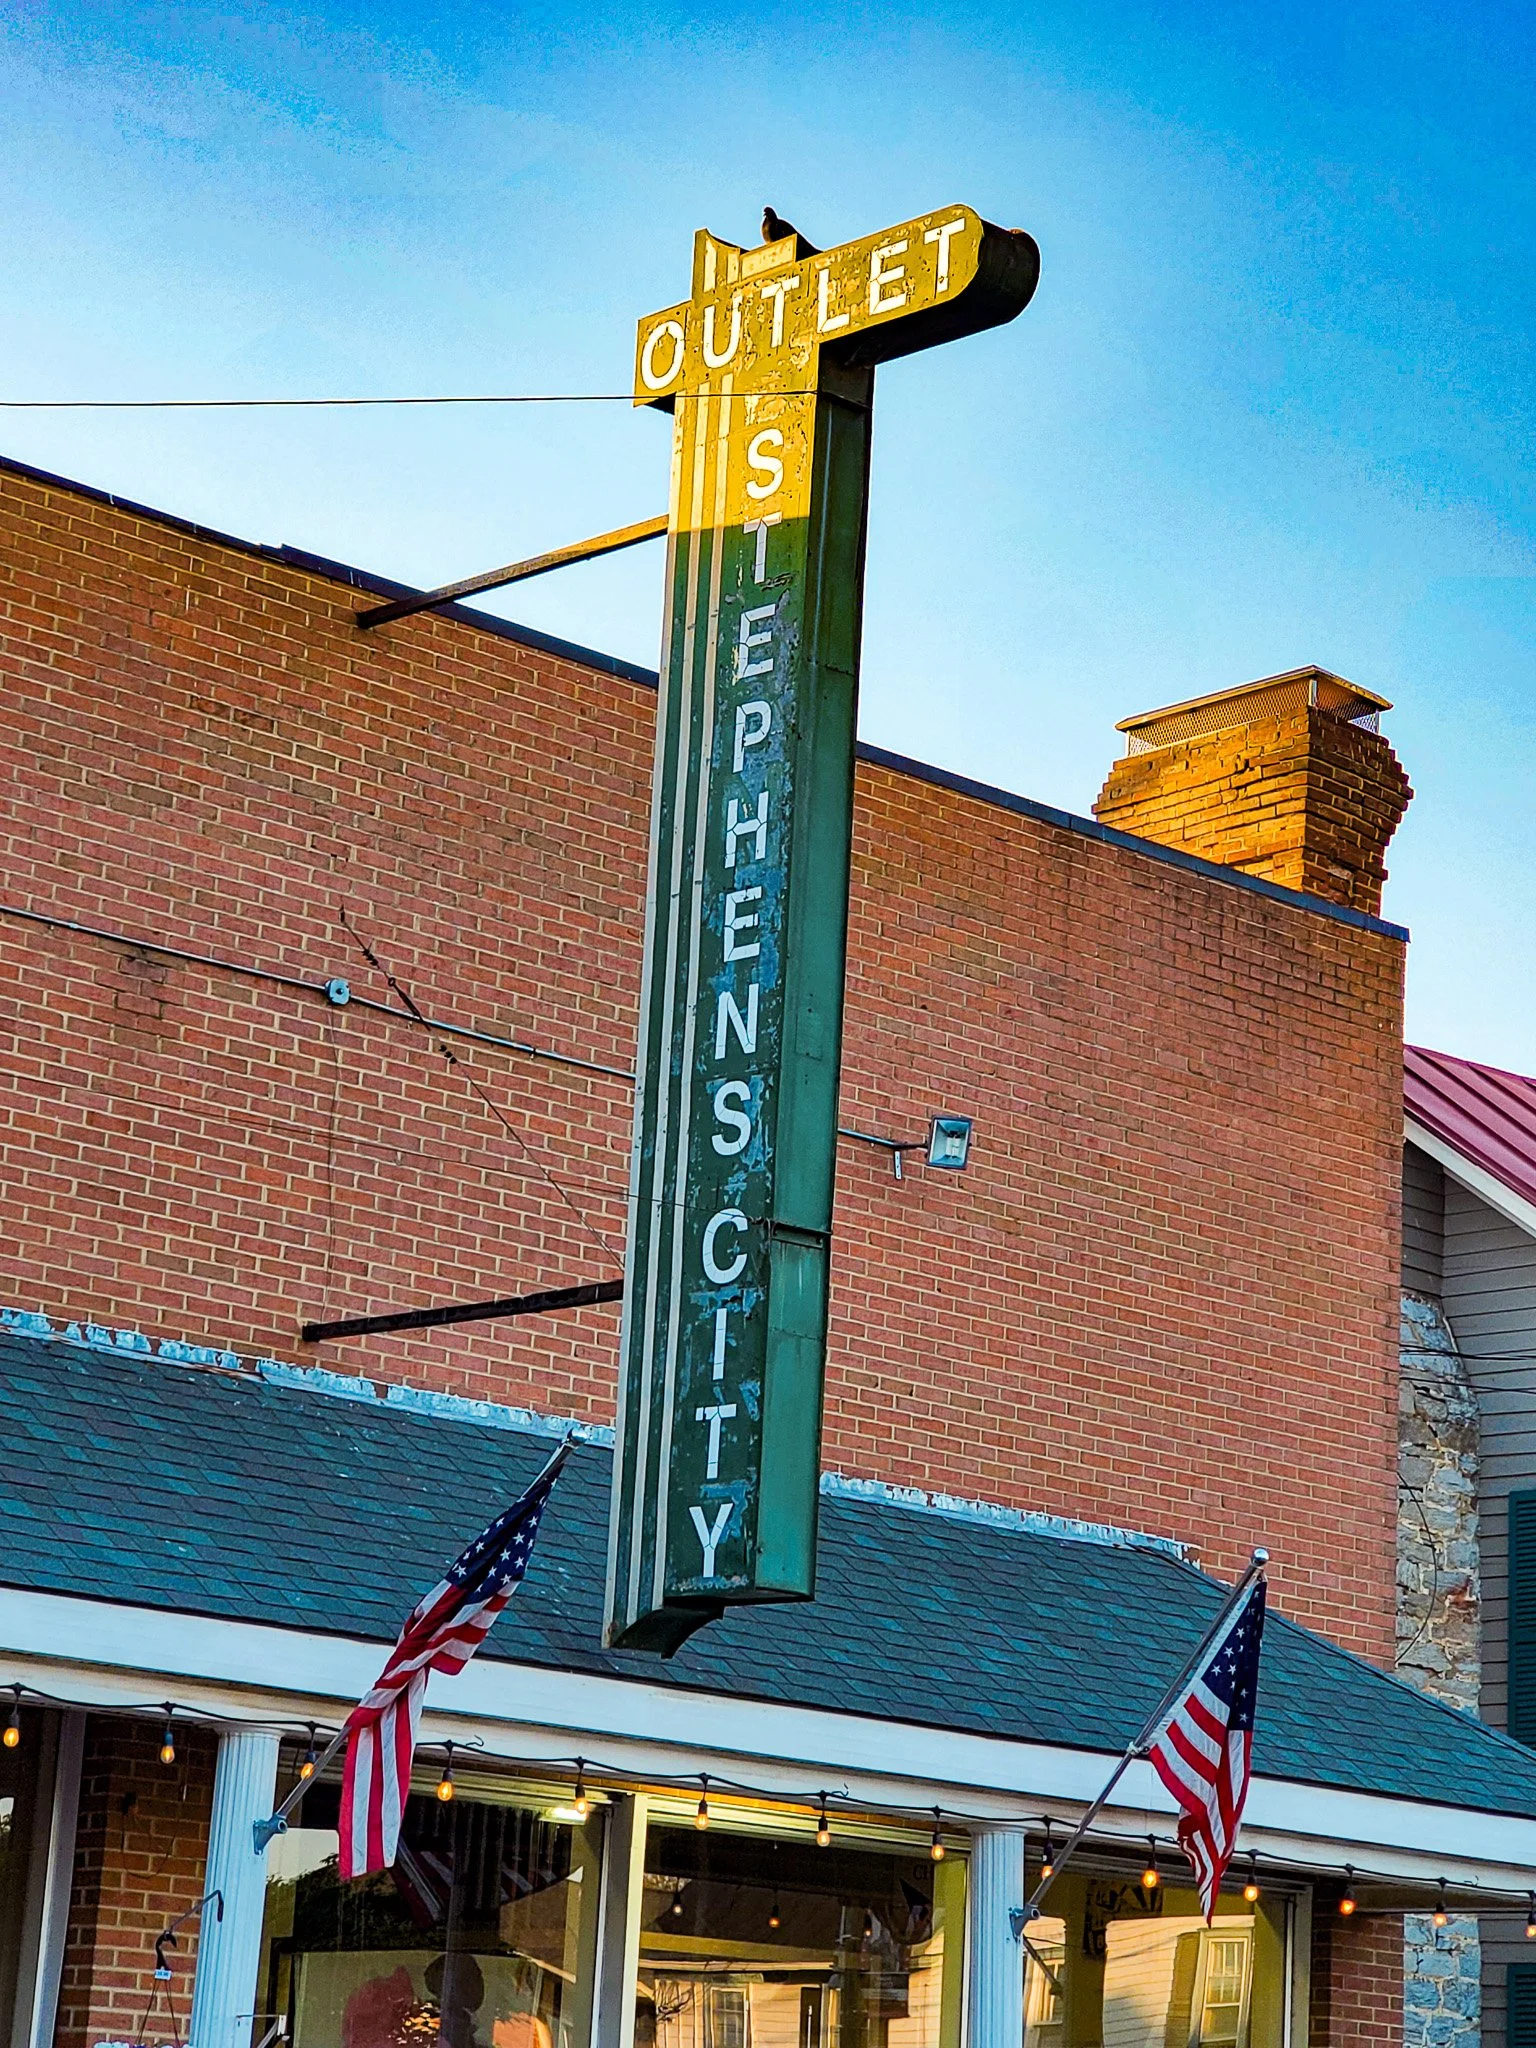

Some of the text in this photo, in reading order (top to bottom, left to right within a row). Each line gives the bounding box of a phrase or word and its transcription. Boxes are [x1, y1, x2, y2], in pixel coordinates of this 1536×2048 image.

[641, 217, 966, 391] OUTLET
[689, 428, 783, 1578] STEPHENS CITY
